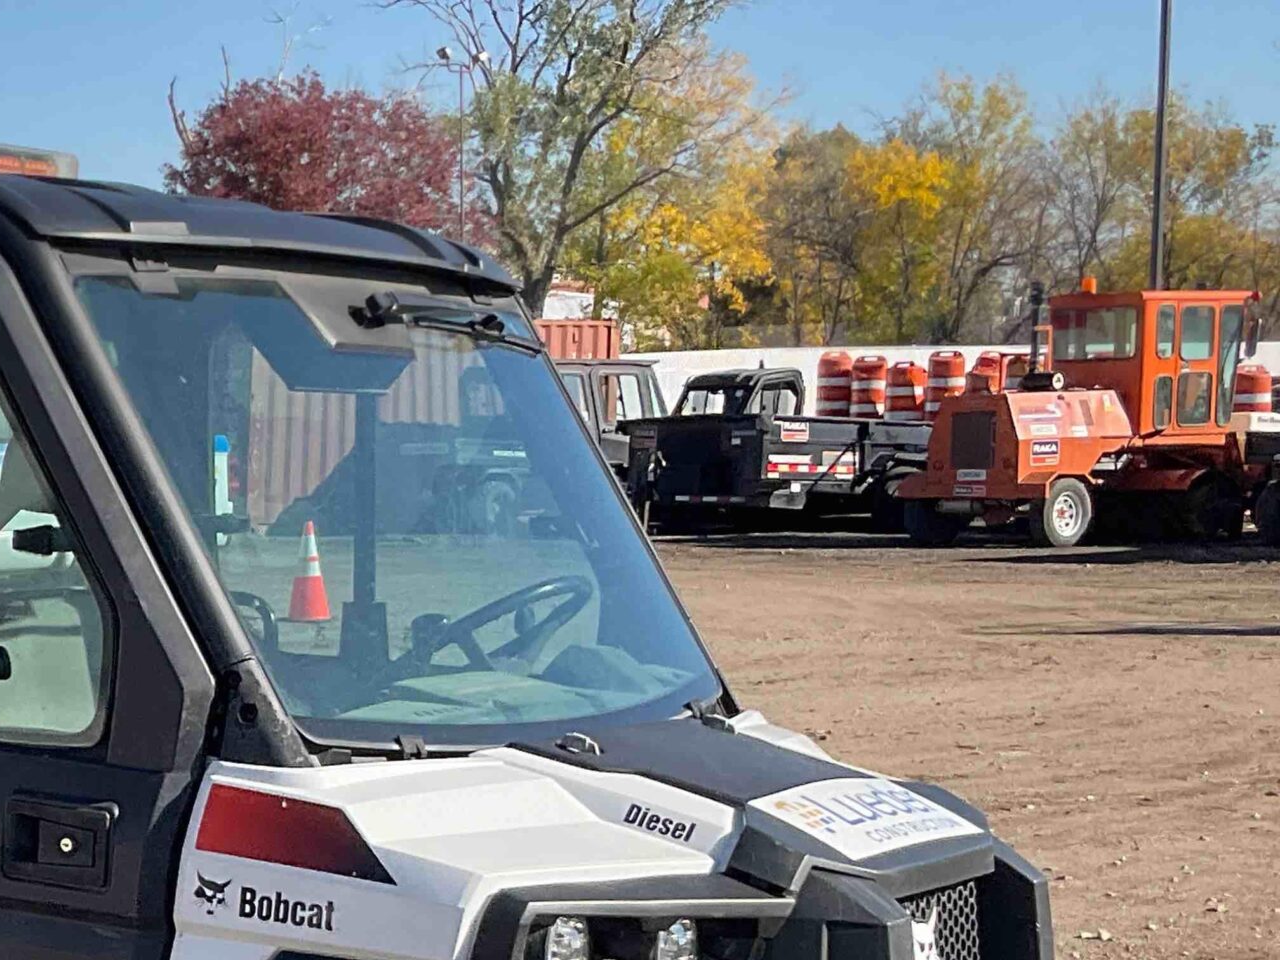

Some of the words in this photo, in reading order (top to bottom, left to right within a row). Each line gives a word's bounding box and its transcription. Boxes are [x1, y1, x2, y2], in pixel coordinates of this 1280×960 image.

[1033, 443, 1058, 453] RAKA
[623, 803, 697, 842] Diesel
[238, 886, 334, 931] Bobcat
